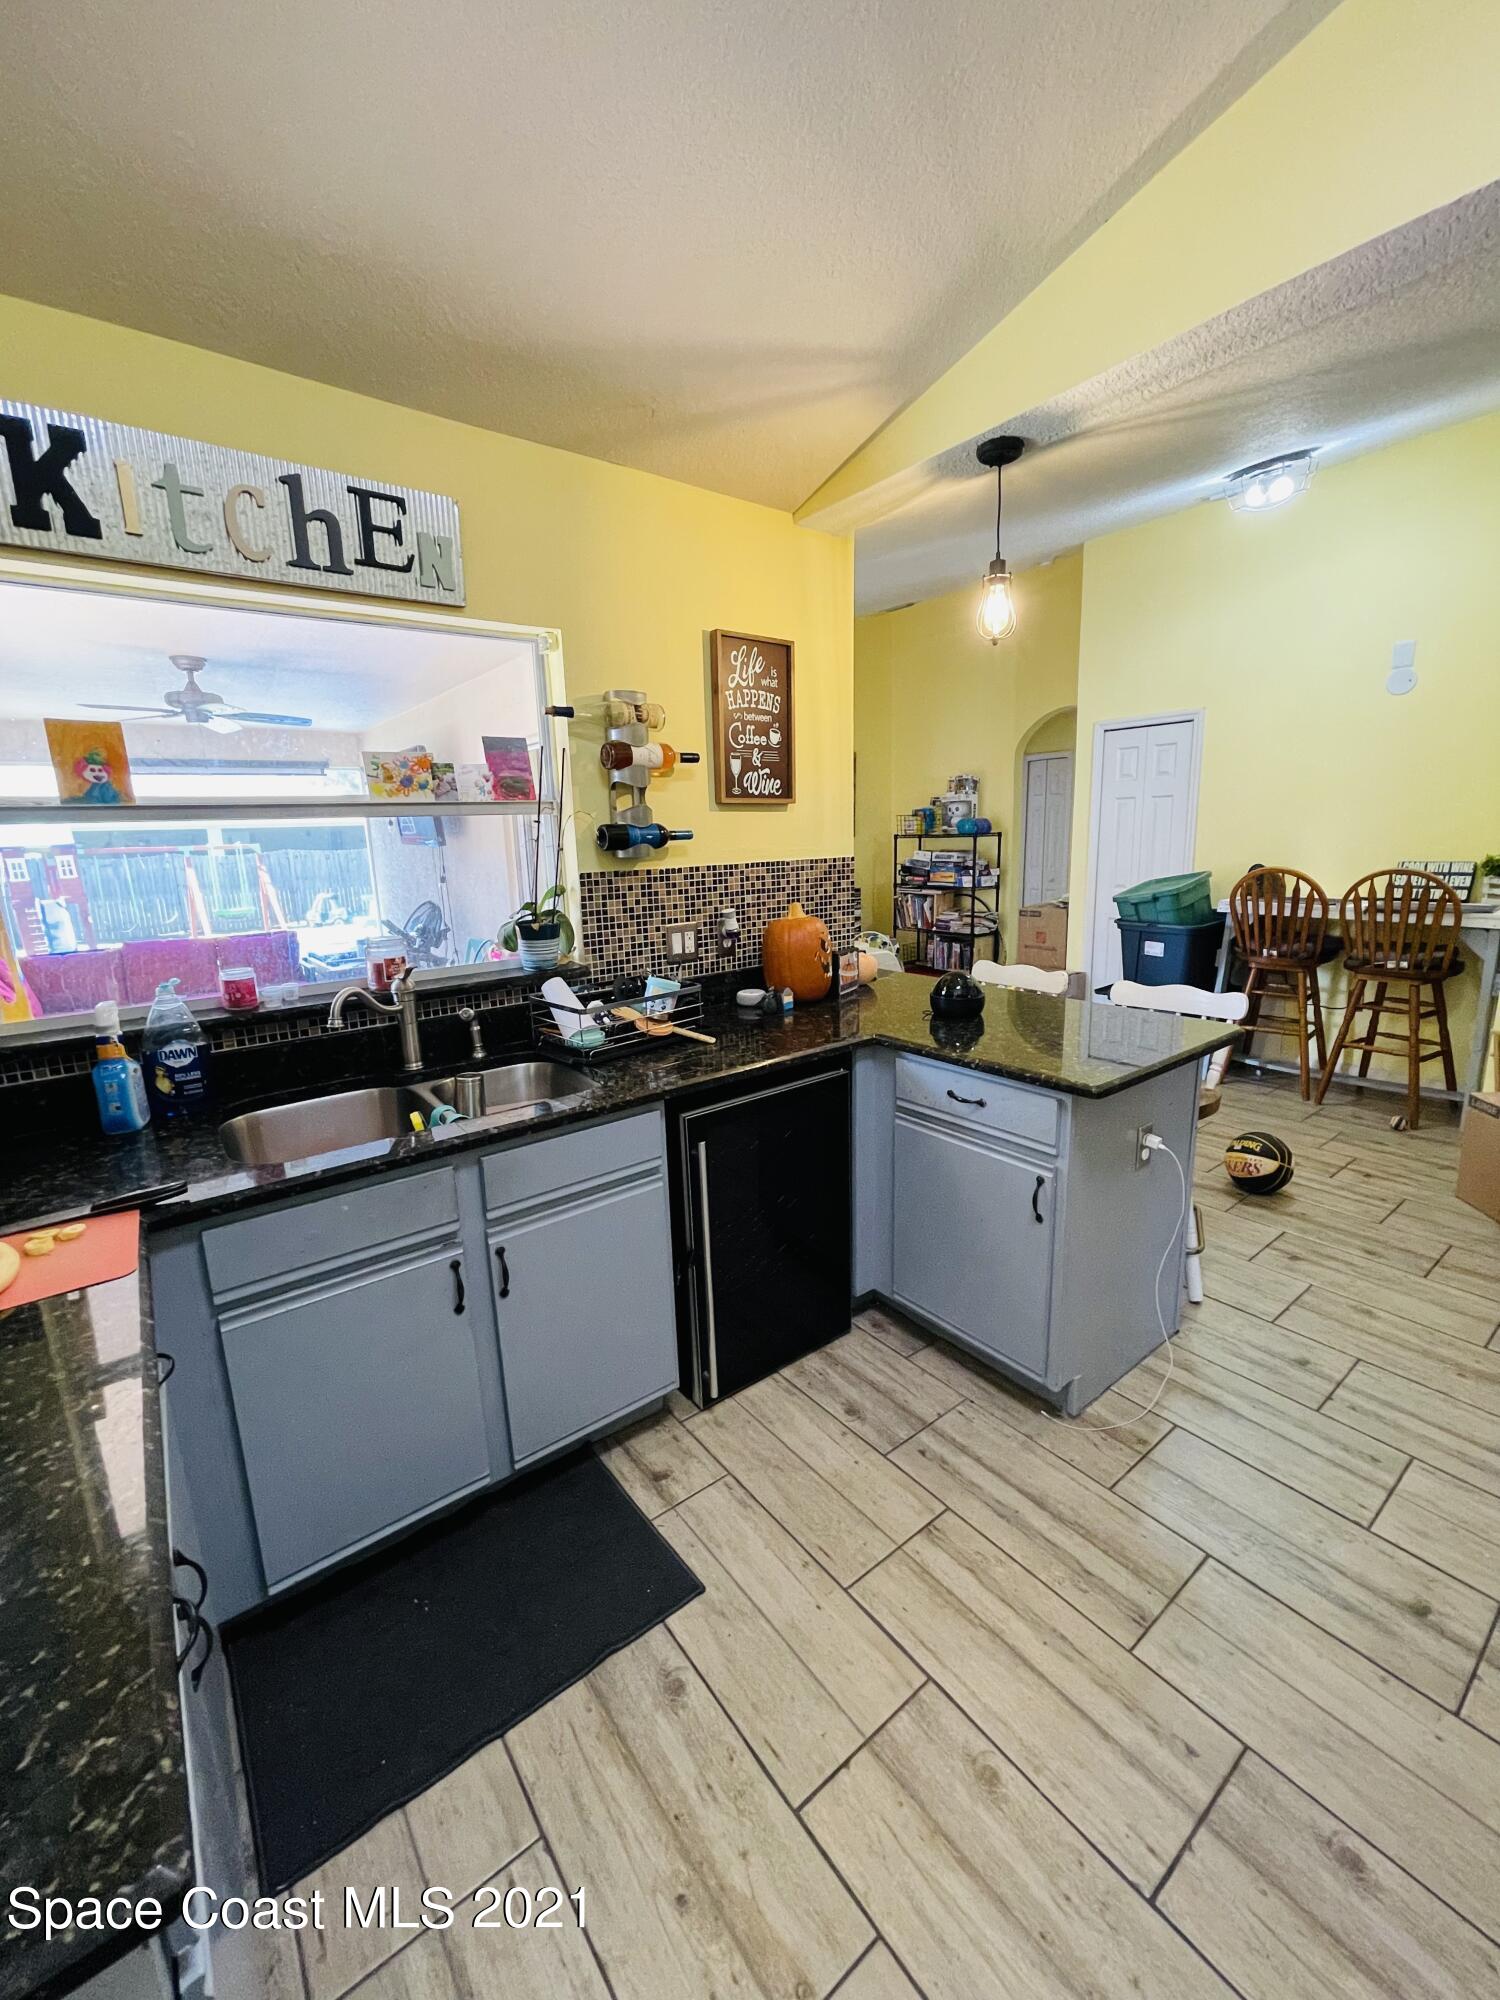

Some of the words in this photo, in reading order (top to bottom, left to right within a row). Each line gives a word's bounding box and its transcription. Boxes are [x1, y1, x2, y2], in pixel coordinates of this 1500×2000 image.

[728, 645, 766, 688] Life
[770, 666, 778, 678] is
[761, 676, 779, 688] what
[725, 688, 781, 714] HAPPENS
[743, 711, 773, 723] between
[728, 721, 768, 749] Coffee
[752, 747, 764, 767] &
[743, 768, 783, 796] Wine
[1427, 862, 1449, 873] WITH
[1449, 875, 1473, 887] EVEN
[159, 1046, 197, 1060] DAWN
